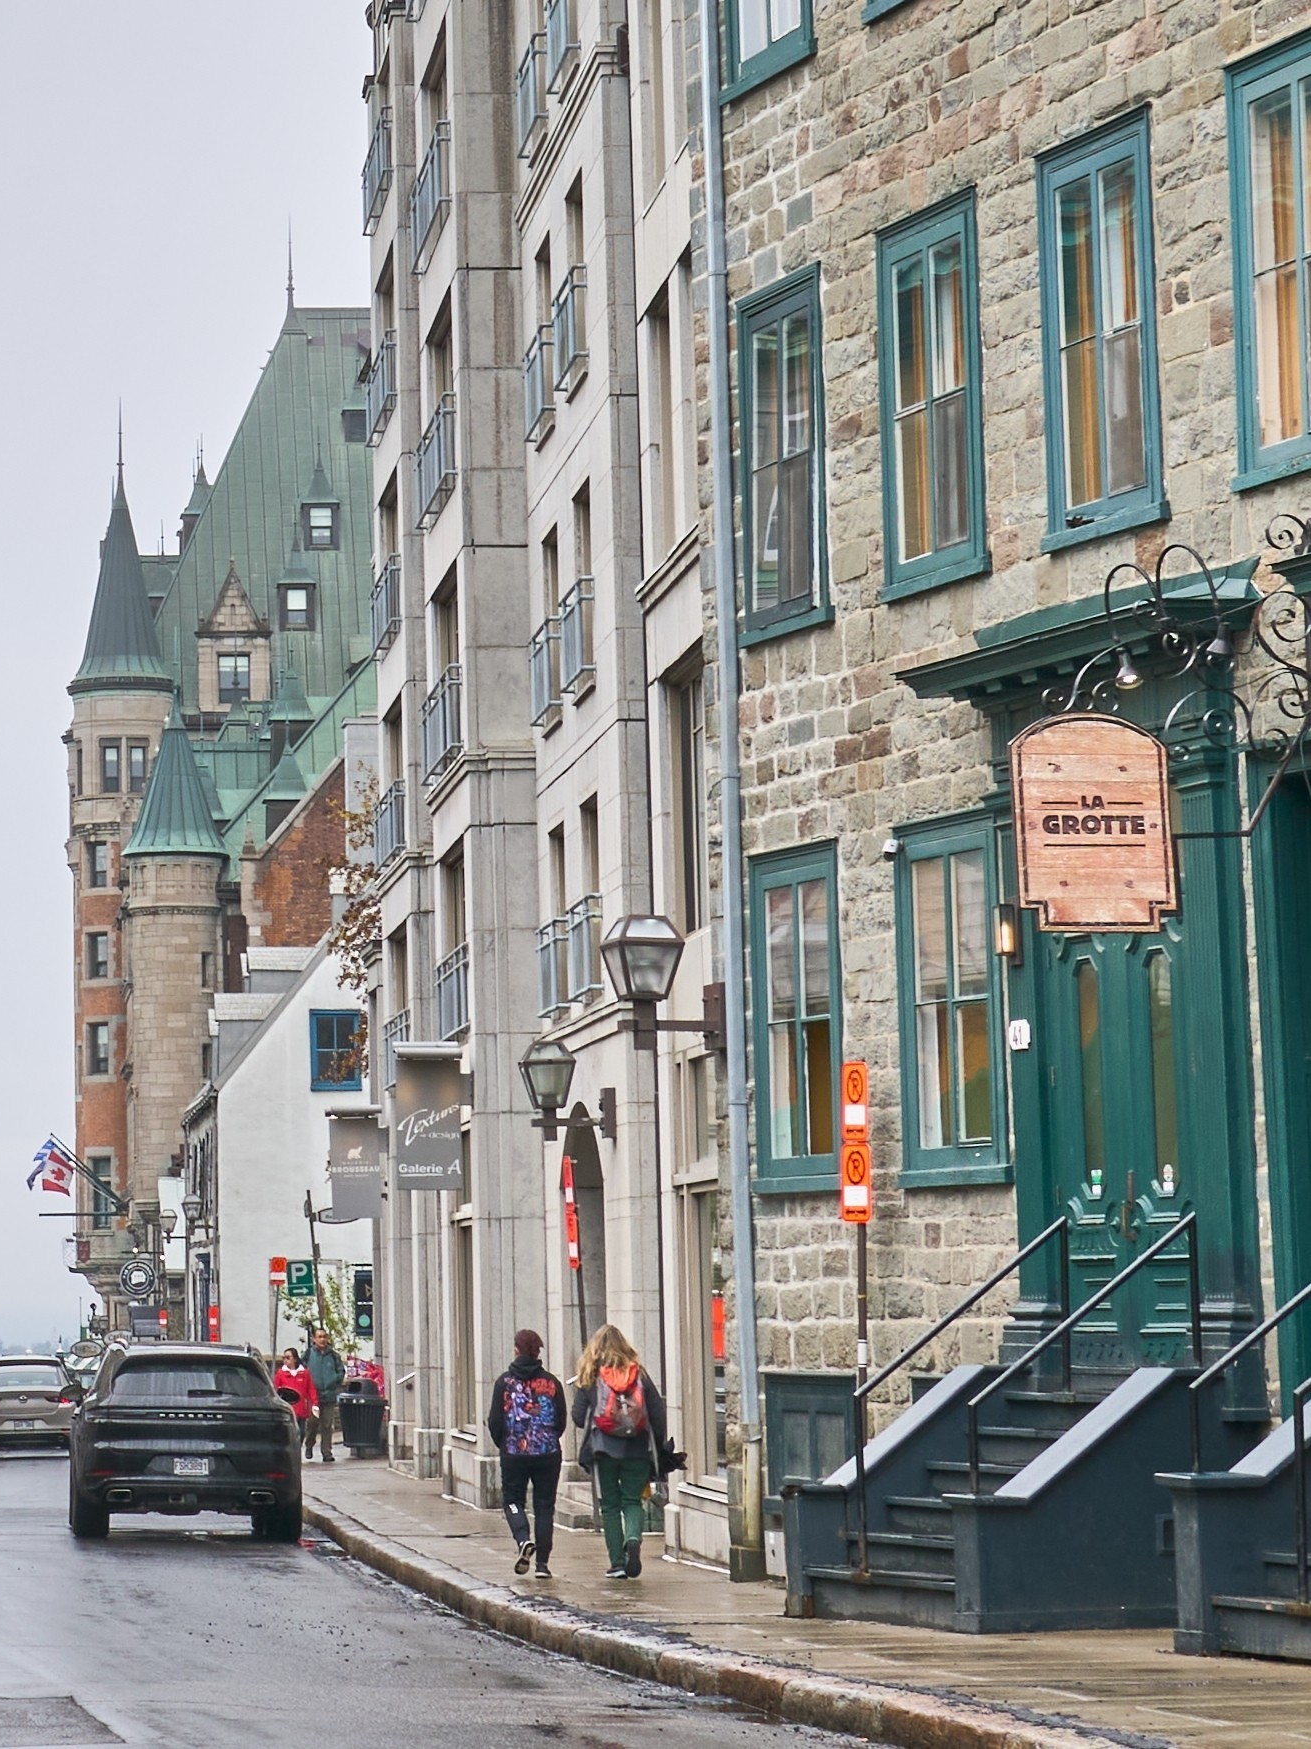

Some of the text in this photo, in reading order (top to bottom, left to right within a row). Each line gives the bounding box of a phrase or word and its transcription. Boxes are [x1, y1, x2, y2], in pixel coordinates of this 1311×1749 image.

[1081, 795, 1106, 810] LA
[1042, 814, 1146, 835] GROTTE
[1012, 1025, 1023, 1045] 41
[332, 1165, 380, 1173] BROUSSEAU
[399, 1159, 462, 1175] Galerie A
[290, 1262, 308, 1283] P
